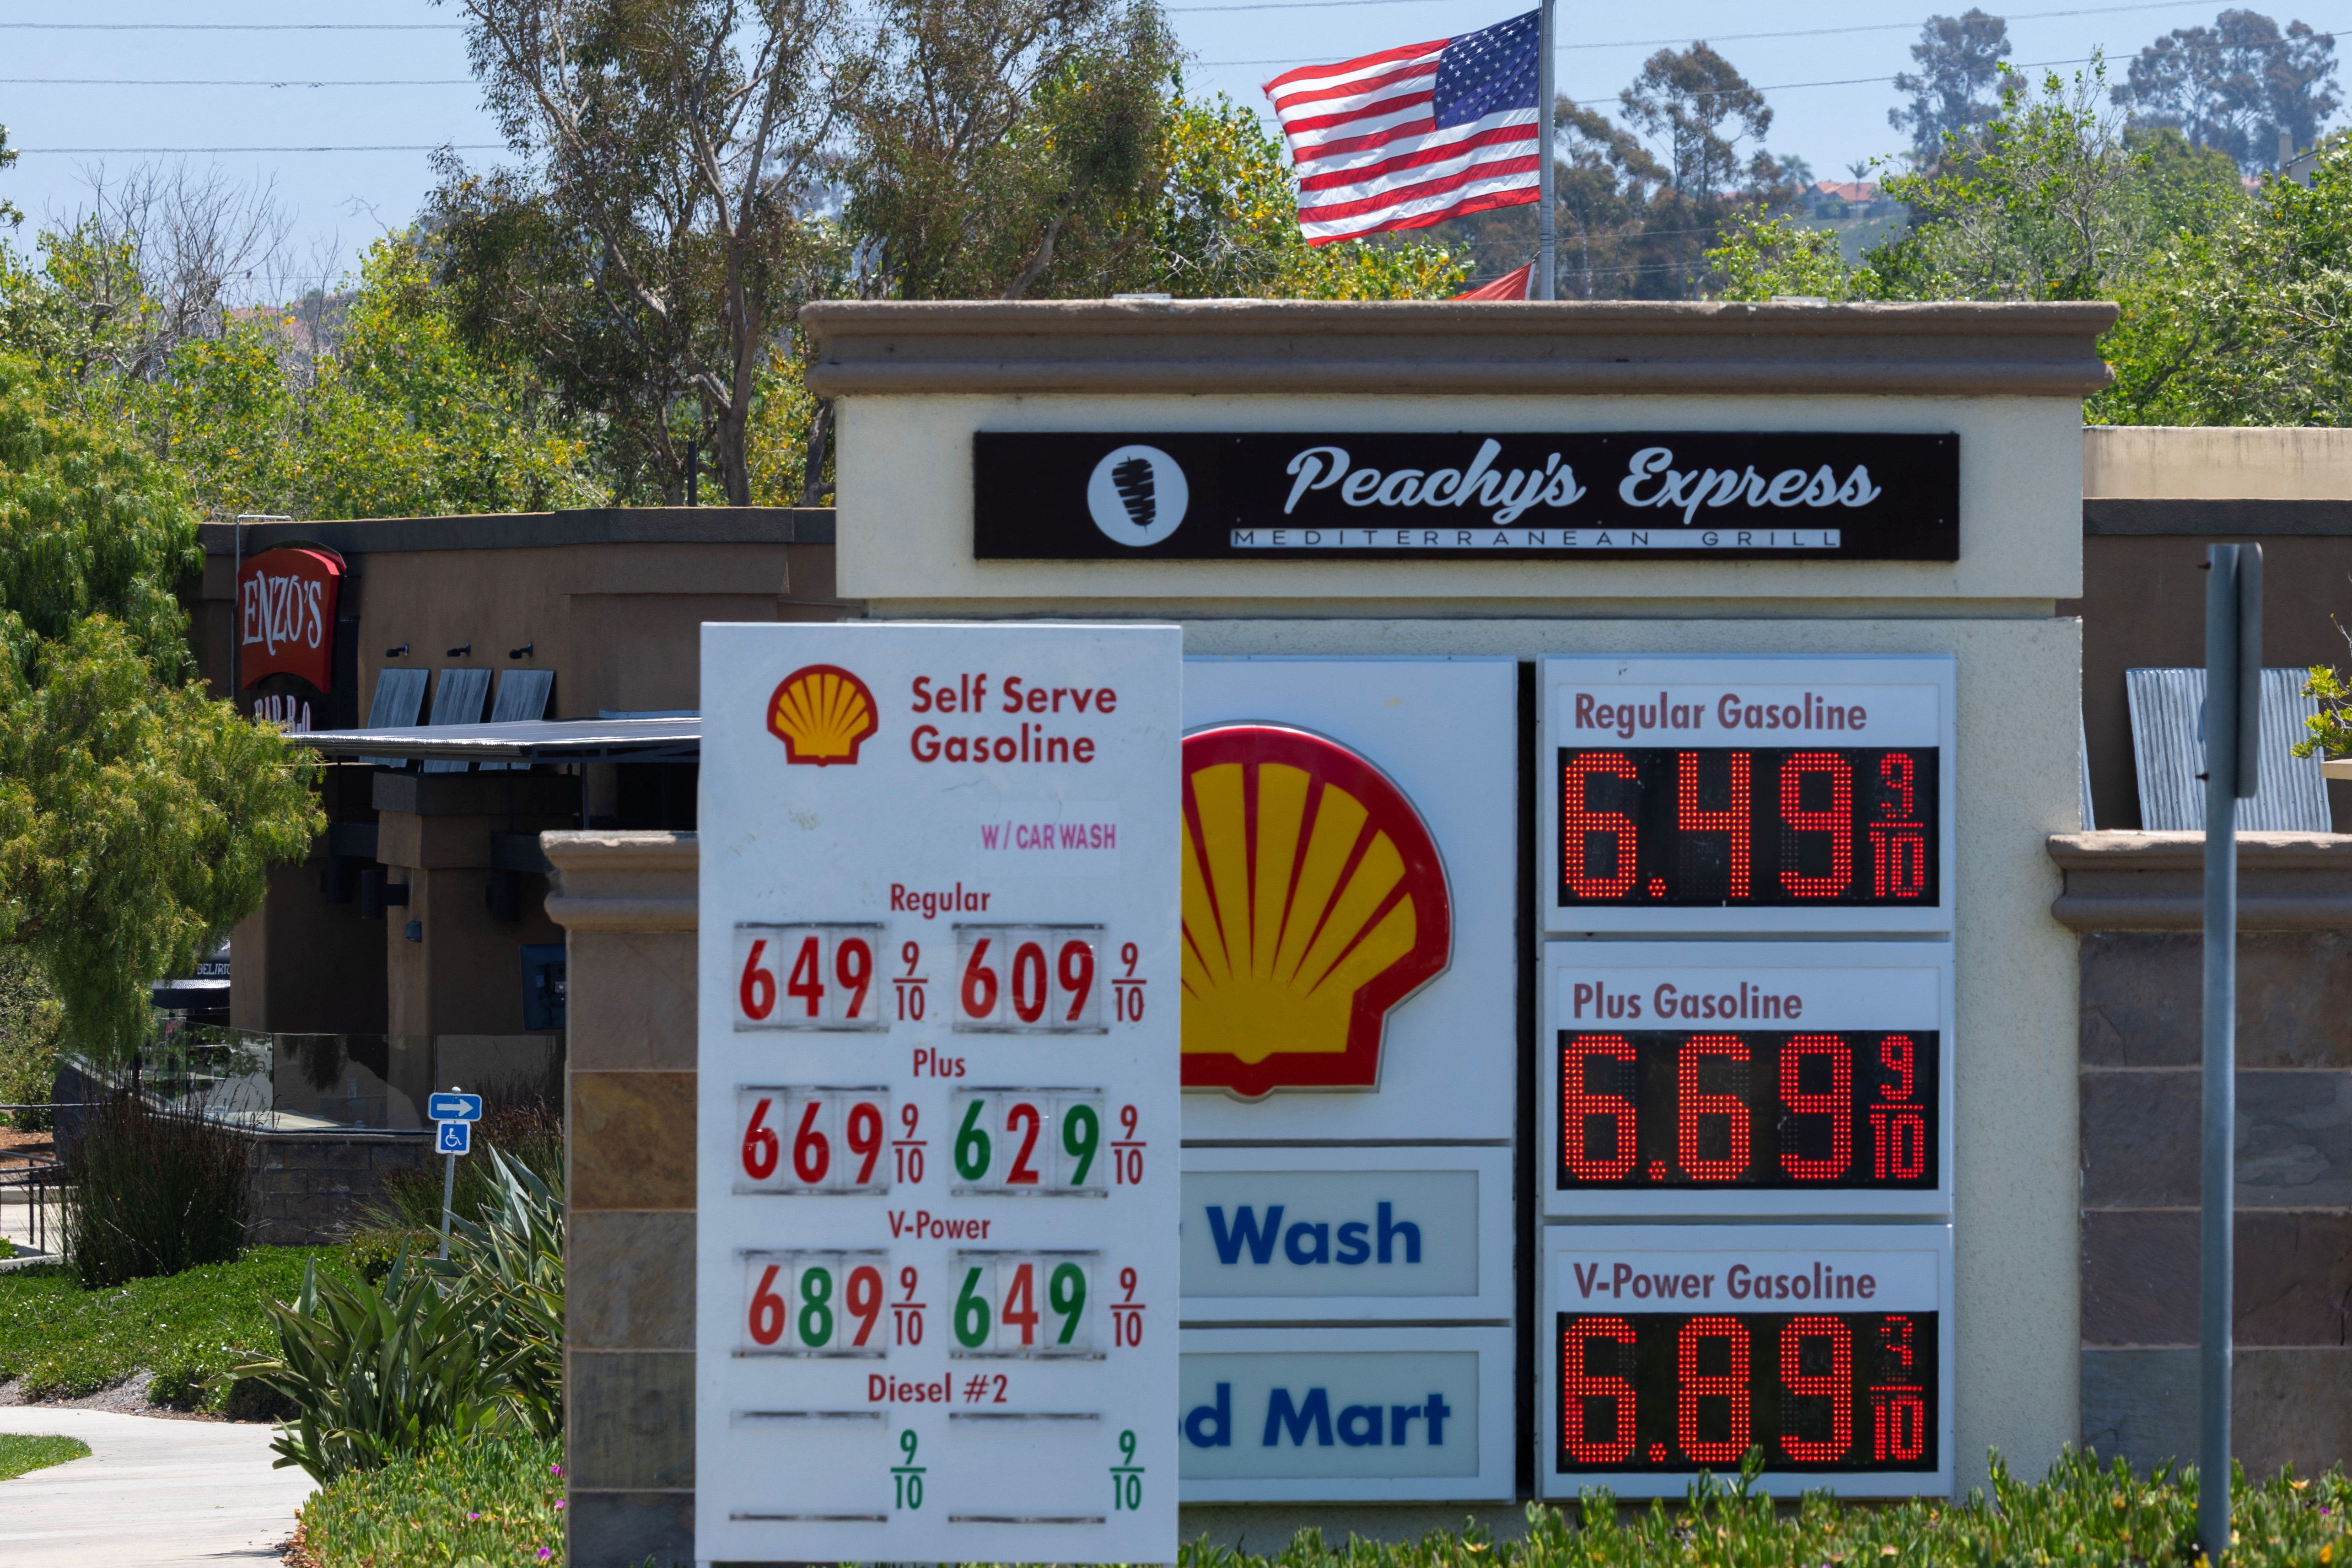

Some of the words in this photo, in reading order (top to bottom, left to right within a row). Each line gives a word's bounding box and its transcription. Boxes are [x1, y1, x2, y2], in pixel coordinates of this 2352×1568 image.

[1284, 439, 1586, 524] Peachy's
[1619, 447, 1881, 524] Express
[1234, 530, 1648, 545] MEDITERRANEAN
[1702, 531, 1836, 546] GRILL
[242, 570, 322, 655] ENZO'S
[912, 673, 986, 713] Self
[1003, 677, 1116, 713] Serve
[1575, 692, 1705, 739] Regular
[1718, 693, 1867, 730] Gasoline
[911, 723, 1094, 763] Gasoline
[1016, 824, 1054, 849] CAR
[1060, 824, 1115, 849] WASH
[1565, 752, 1851, 897] 6.49
[1870, 832, 1923, 897] 10
[891, 882, 990, 919] Regular
[741, 937, 871, 1020] 649
[962, 940, 1093, 1021] 609
[1574, 982, 1642, 1019] Plus
[1653, 982, 1803, 1020] Gasoline
[914, 1047, 965, 1077] Plus
[1564, 1035, 1851, 1180] 6.69
[743, 1100, 882, 1183] 669
[955, 1102, 1098, 1184] 629
[1870, 1114, 1923, 1178] 10
[888, 1211, 990, 1239] V-Power
[1206, 1202, 1421, 1265] Wash
[748, 1265, 883, 1347] 689
[957, 1265, 1085, 1346] 649
[1574, 1262, 1715, 1299] V-Power
[1727, 1262, 1876, 1300] Gasoline
[869, 1373, 951, 1402] Diesel
[964, 1375, 1007, 1402] #2
[1178, 1382, 1231, 1448] d
[1262, 1387, 1451, 1448] Mart
[1565, 1316, 1852, 1462] 6.89
